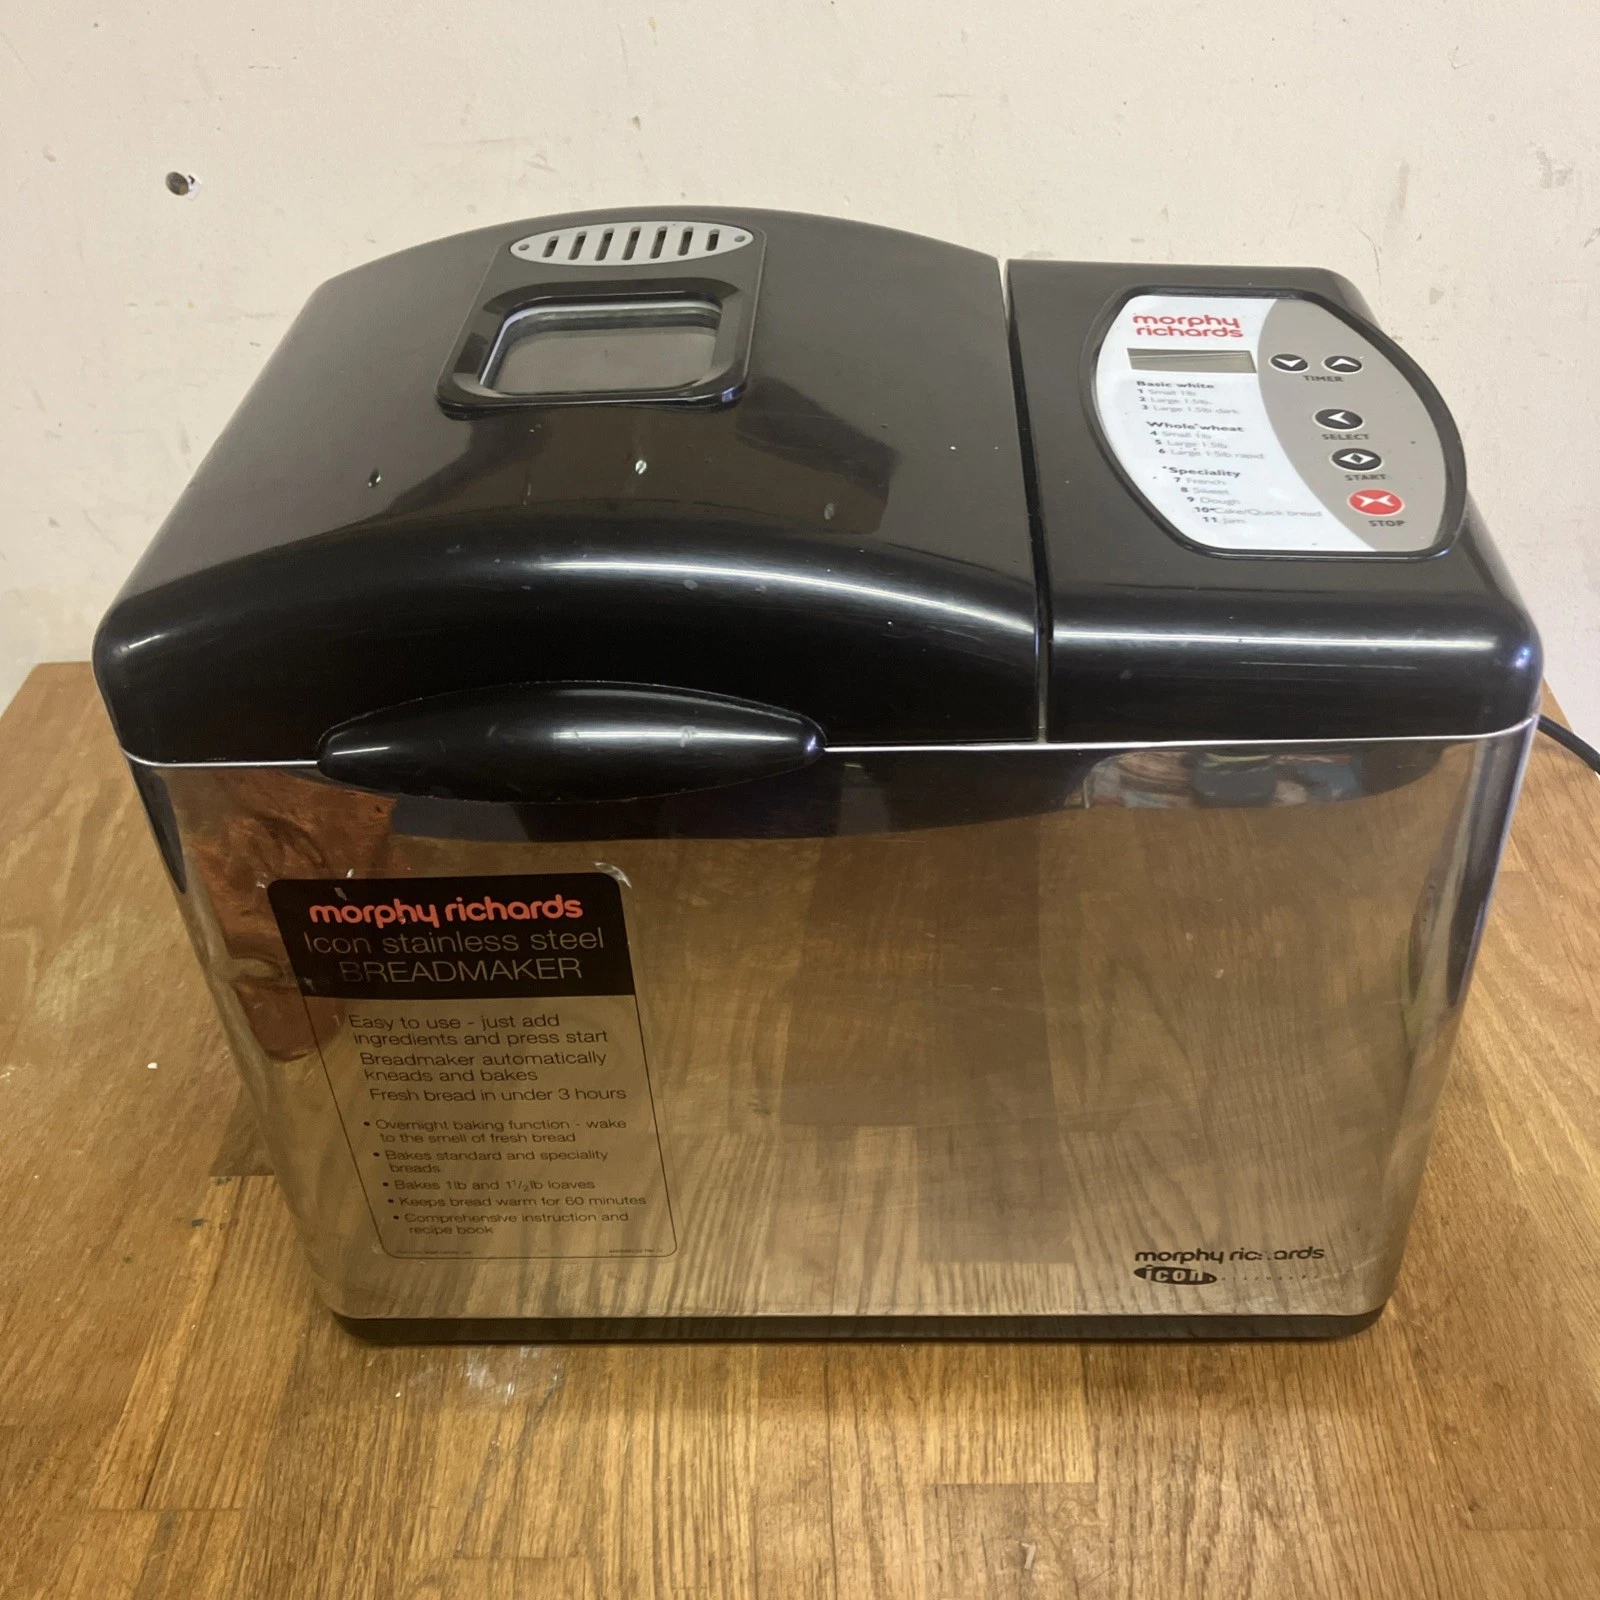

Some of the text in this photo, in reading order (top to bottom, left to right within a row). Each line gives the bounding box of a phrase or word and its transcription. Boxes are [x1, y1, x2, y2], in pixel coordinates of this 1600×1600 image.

[1133, 315, 1240, 328] morphy
[1136, 325, 1243, 338] richards
[1146, 421, 1244, 432] Whole wheat
[1321, 433, 1370, 441] SELECT
[1168, 467, 1241, 478] Speciality
[1344, 473, 1387, 481] START
[309, 894, 584, 929] morphy richards
[303, 927, 604, 954] Icon stainless steel
[340, 957, 583, 983] BREADMAKER
[349, 1014, 394, 1031] Easy
[400, 1017, 420, 1029] to
[426, 1018, 461, 1029] use
[481, 1015, 516, 1031] just
[522, 1013, 560, 1028] add
[353, 1030, 608, 1048] ingredients and press start
[360, 1051, 607, 1067] Breadmaker automatically
[364, 1069, 538, 1082] kneads and bakes
[370, 1088, 627, 1101] Fresh bread in under 3 hours
[375, 1119, 449, 1133] Overnight
[453, 1120, 504, 1133] baking
[508, 1120, 570, 1130] function
[586, 1118, 627, 1129] wake
[380, 1132, 576, 1144] to the smell of fresh bread
[385, 1150, 608, 1163] Bakes standard and speciality
[389, 1163, 441, 1173] breads
[394, 1180, 440, 1190] Bakes
[472, 1181, 500, 1190] and
[548, 1180, 596, 1190] loaves
[399, 1197, 647, 1208] Keeps bread warm for 60 minutes
[404, 1212, 630, 1224] Comprehensive instruction and
[409, 1226, 495, 1236] recipe book
[1135, 1247, 1325, 1265] morphy ricards
